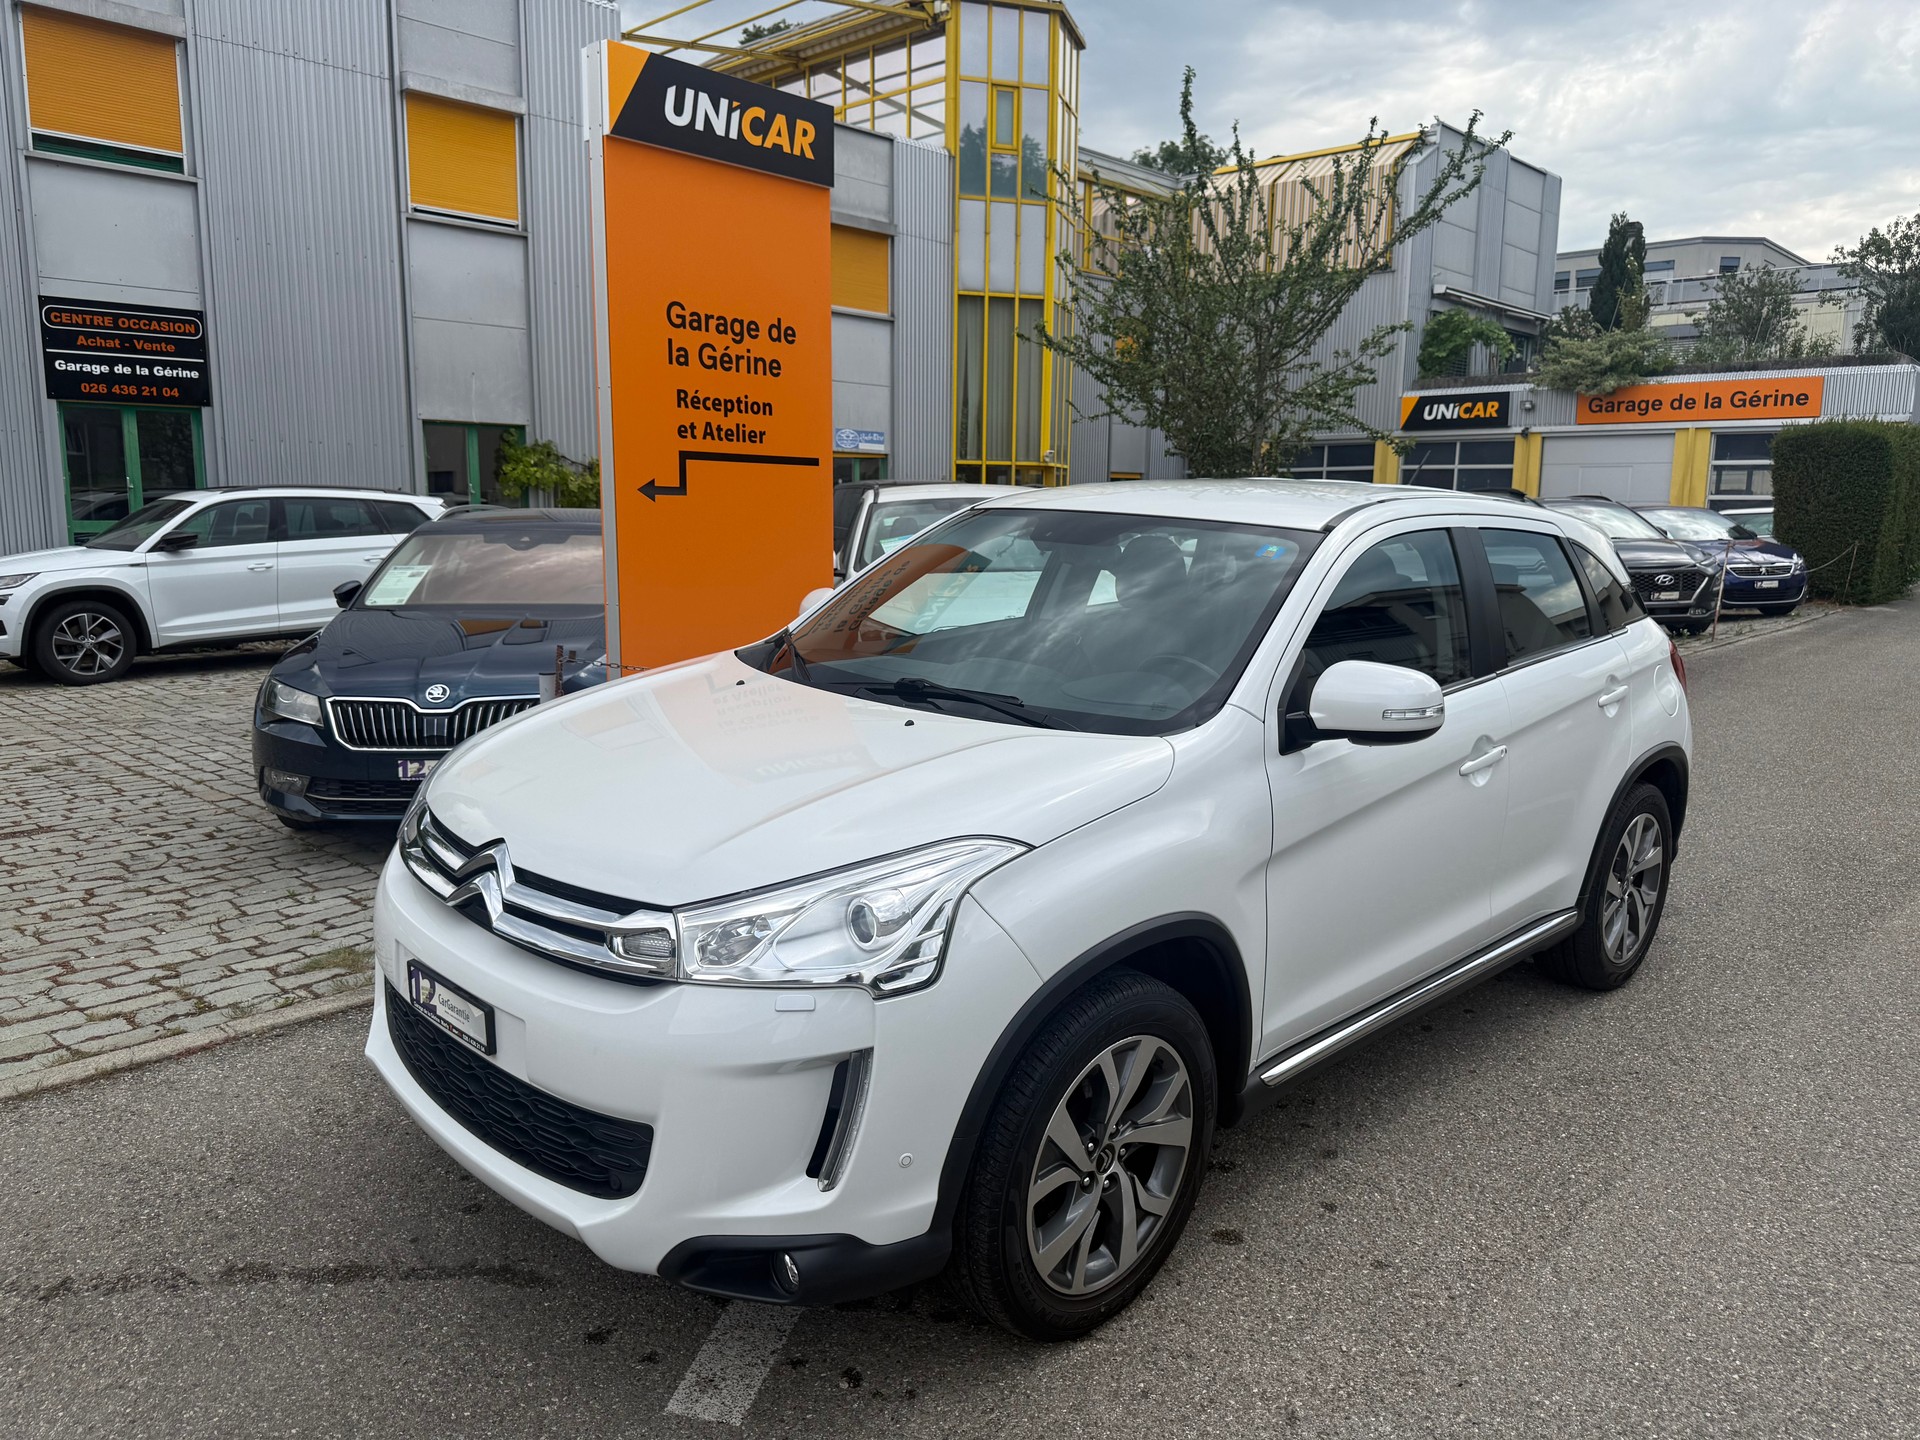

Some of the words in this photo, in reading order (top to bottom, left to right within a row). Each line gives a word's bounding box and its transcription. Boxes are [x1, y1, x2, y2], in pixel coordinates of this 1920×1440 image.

[50, 311, 114, 328] CENTRE
[118, 317, 196, 334] OCCASION
[666, 301, 760, 344] Garage
[768, 317, 797, 345] de
[76, 335, 121, 349] Achat
[133, 339, 176, 353] Vente
[54, 359, 110, 375] Garage
[114, 363, 132, 375] de
[135, 364, 150, 376] la
[153, 365, 200, 379] Gérine
[667, 338, 690, 367] la
[698, 343, 782, 378] Gérine
[80, 383, 108, 394] 026
[111, 384, 138, 396] 436
[141, 386, 157, 396] 21
[162, 387, 180, 398] 04
[676, 388, 773, 418] Réception
[1588, 394, 1663, 416] Garage
[1670, 393, 1697, 411] de
[1703, 391, 1722, 409] la
[1729, 389, 1810, 408] Gérine
[677, 421, 697, 440] et
[702, 421, 767, 444] Atelier
[399, 760, 426, 777] 12
[410, 966, 437, 1015] 12
[438, 993, 470, 1023] CarGarantie
